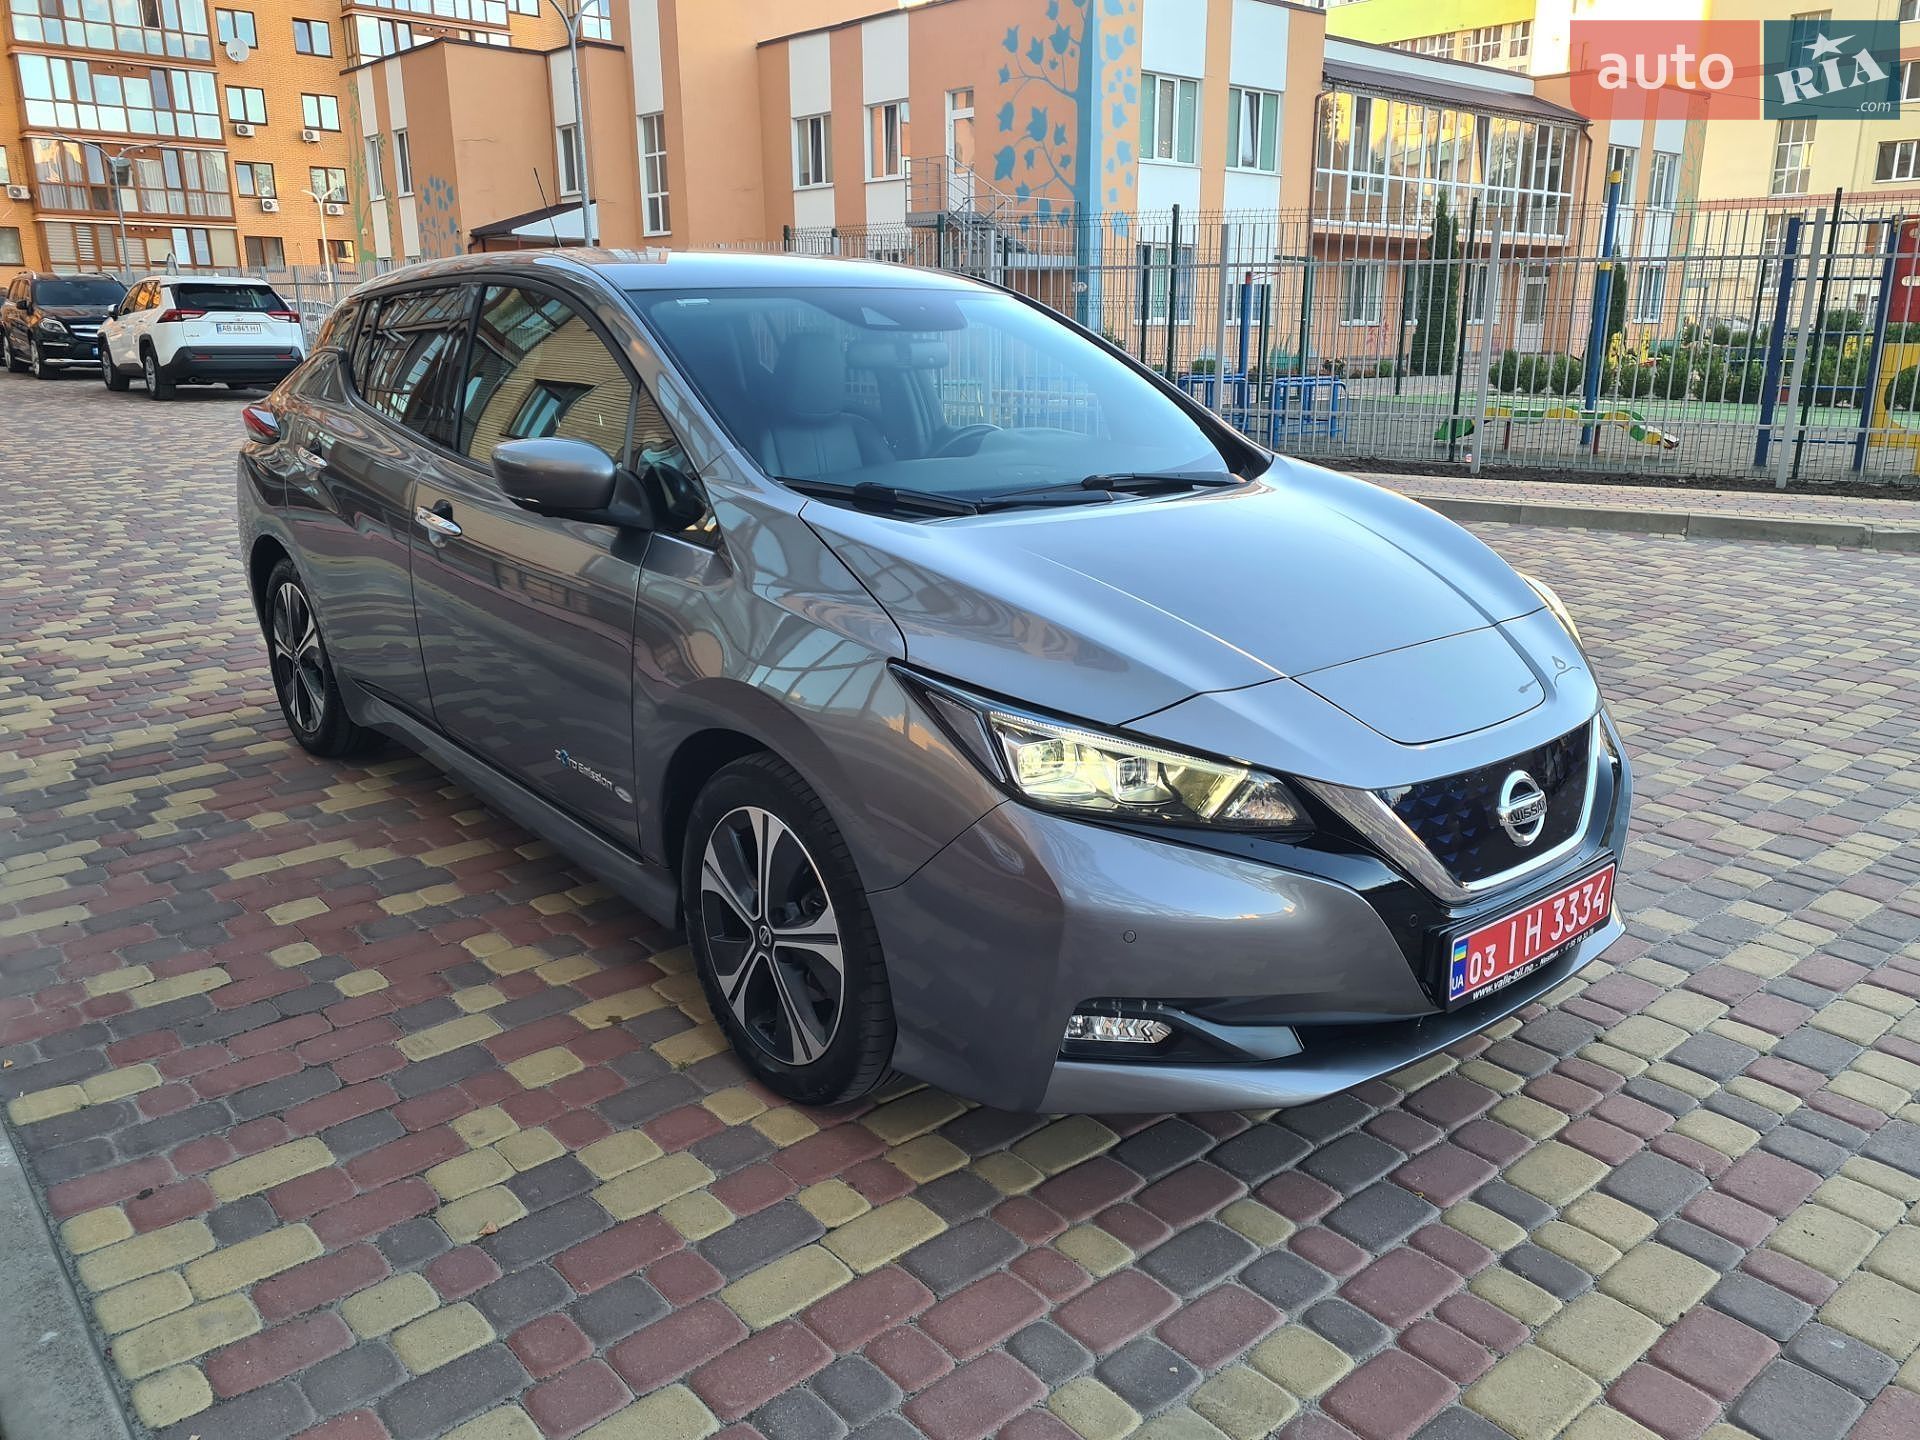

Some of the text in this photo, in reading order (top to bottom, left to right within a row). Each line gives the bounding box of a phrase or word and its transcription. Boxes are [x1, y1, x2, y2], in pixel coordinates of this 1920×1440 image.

[1469, 943, 1497, 985] 03
[1508, 908, 1543, 964] IH
[1550, 875, 1607, 941] 3334
[1452, 974, 1464, 991] UA
